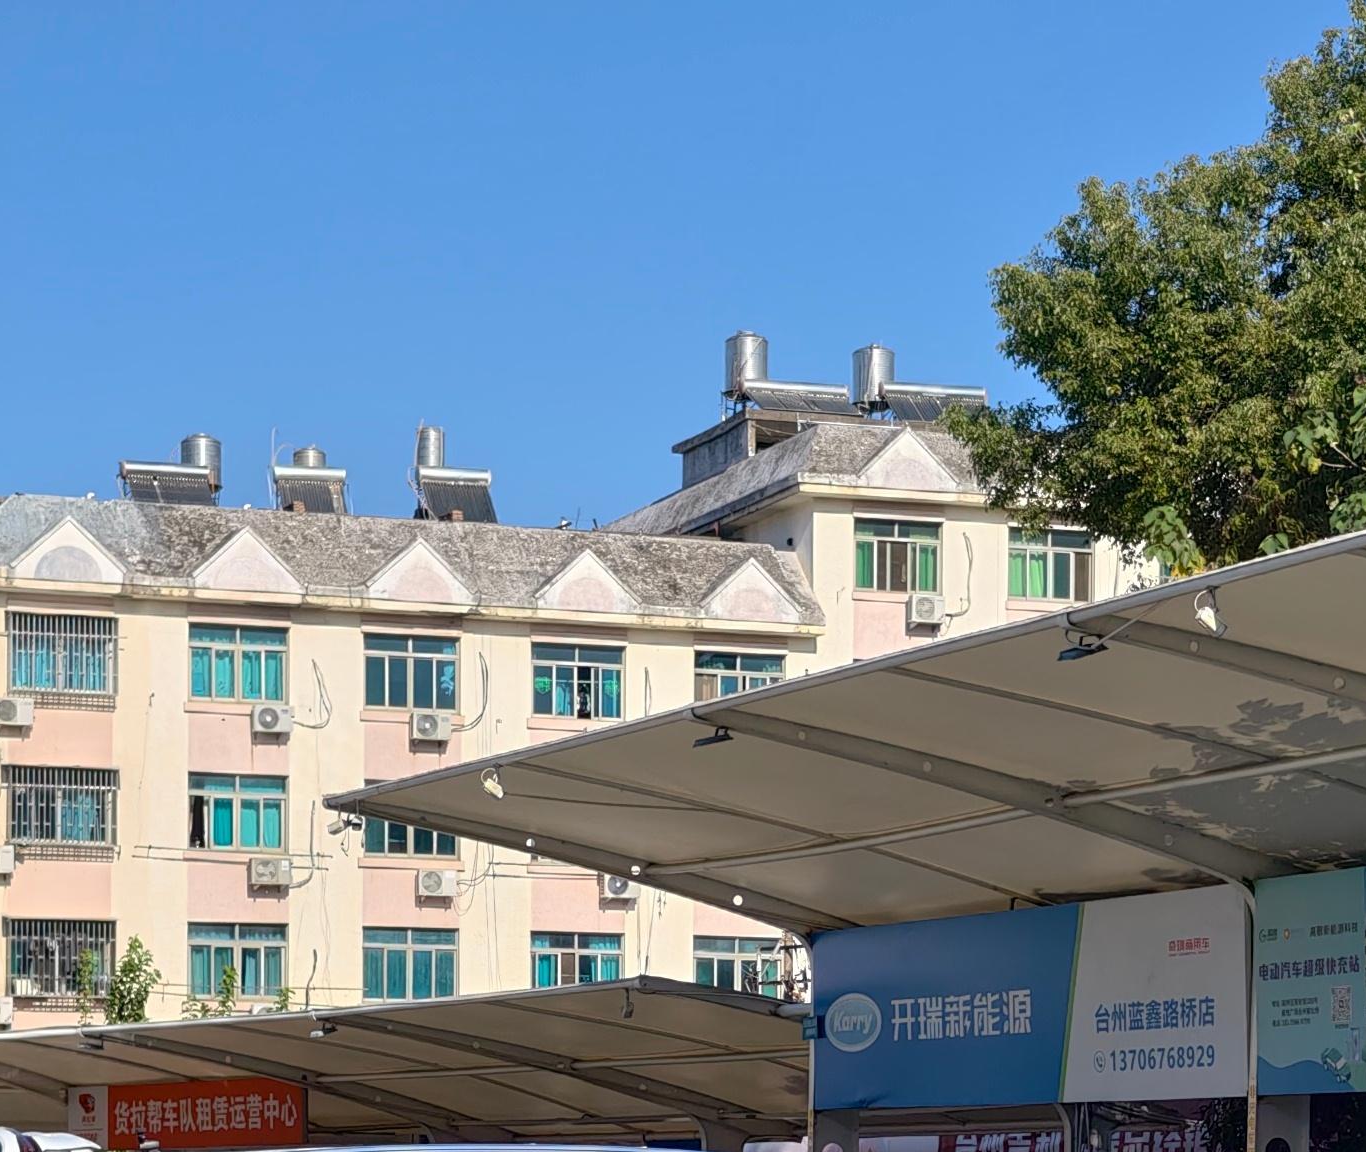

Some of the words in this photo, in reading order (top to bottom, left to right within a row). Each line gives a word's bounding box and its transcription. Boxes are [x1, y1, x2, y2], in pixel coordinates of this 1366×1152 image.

[1258, 954, 1360, 981] 电动汽车超级快充站
[834, 1010, 873, 1036] Karry
[890, 989, 1032, 1042] 开瑞新能源
[1093, 997, 1215, 1034] 台州蓝鑫路桥店
[1109, 1045, 1215, 1073] 13706768929
[114, 1092, 297, 1135] 货拉帮车队租赁运营中心
